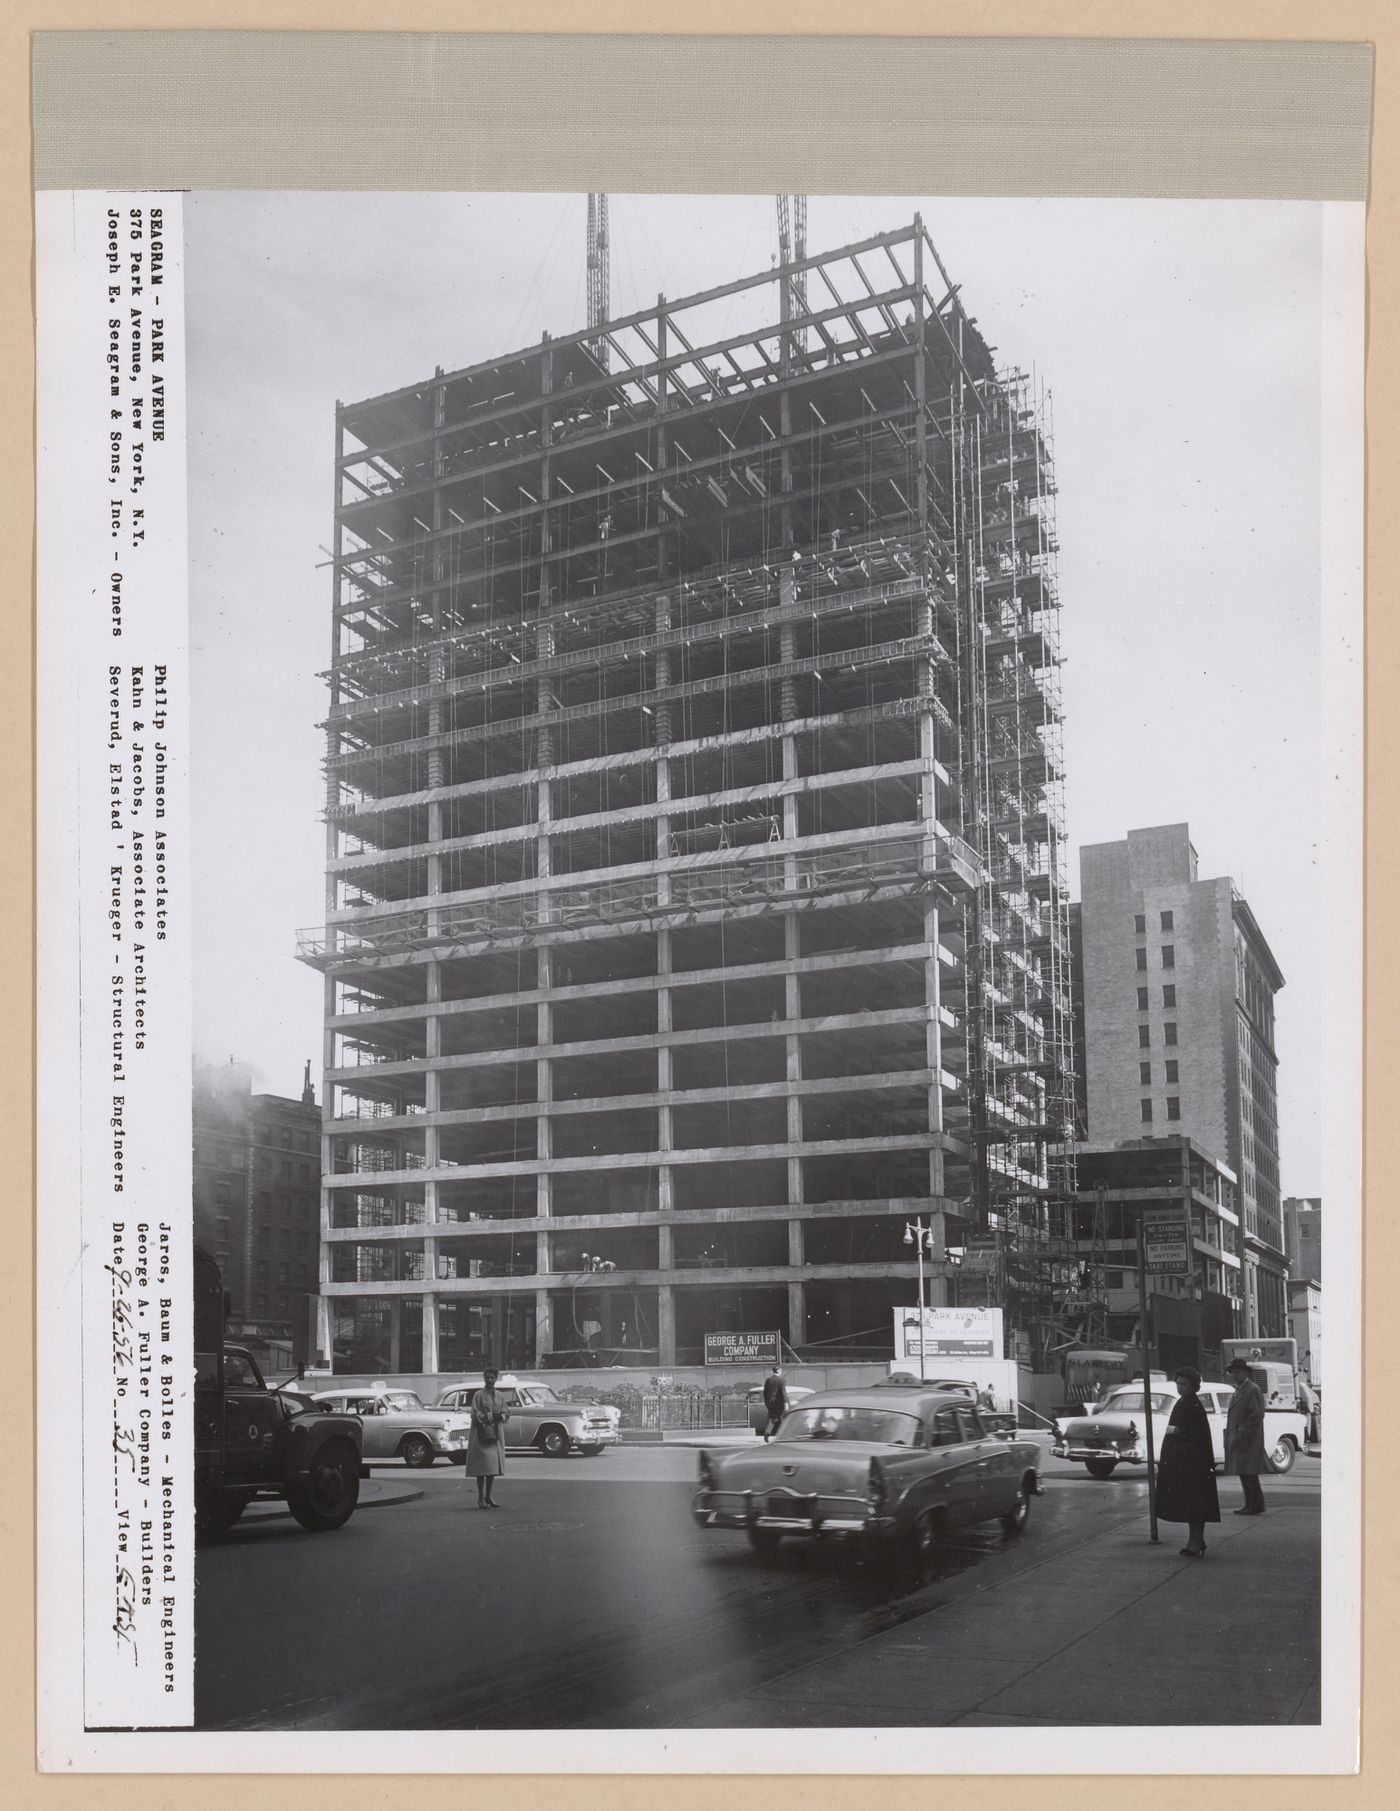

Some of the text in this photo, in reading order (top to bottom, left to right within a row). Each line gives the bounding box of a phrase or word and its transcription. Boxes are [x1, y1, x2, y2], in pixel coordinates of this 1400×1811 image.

[1153, 1252, 1182, 1260] ANYTIME
[929, 1311, 952, 1321] PARK
[954, 1311, 990, 1321] AVENUE
[707, 1334, 776, 1347] GEORGE A. FULLER
[723, 1345, 759, 1356] COMPANY
[708, 1354, 777, 1363] BUILDING CONSTRUCTION
